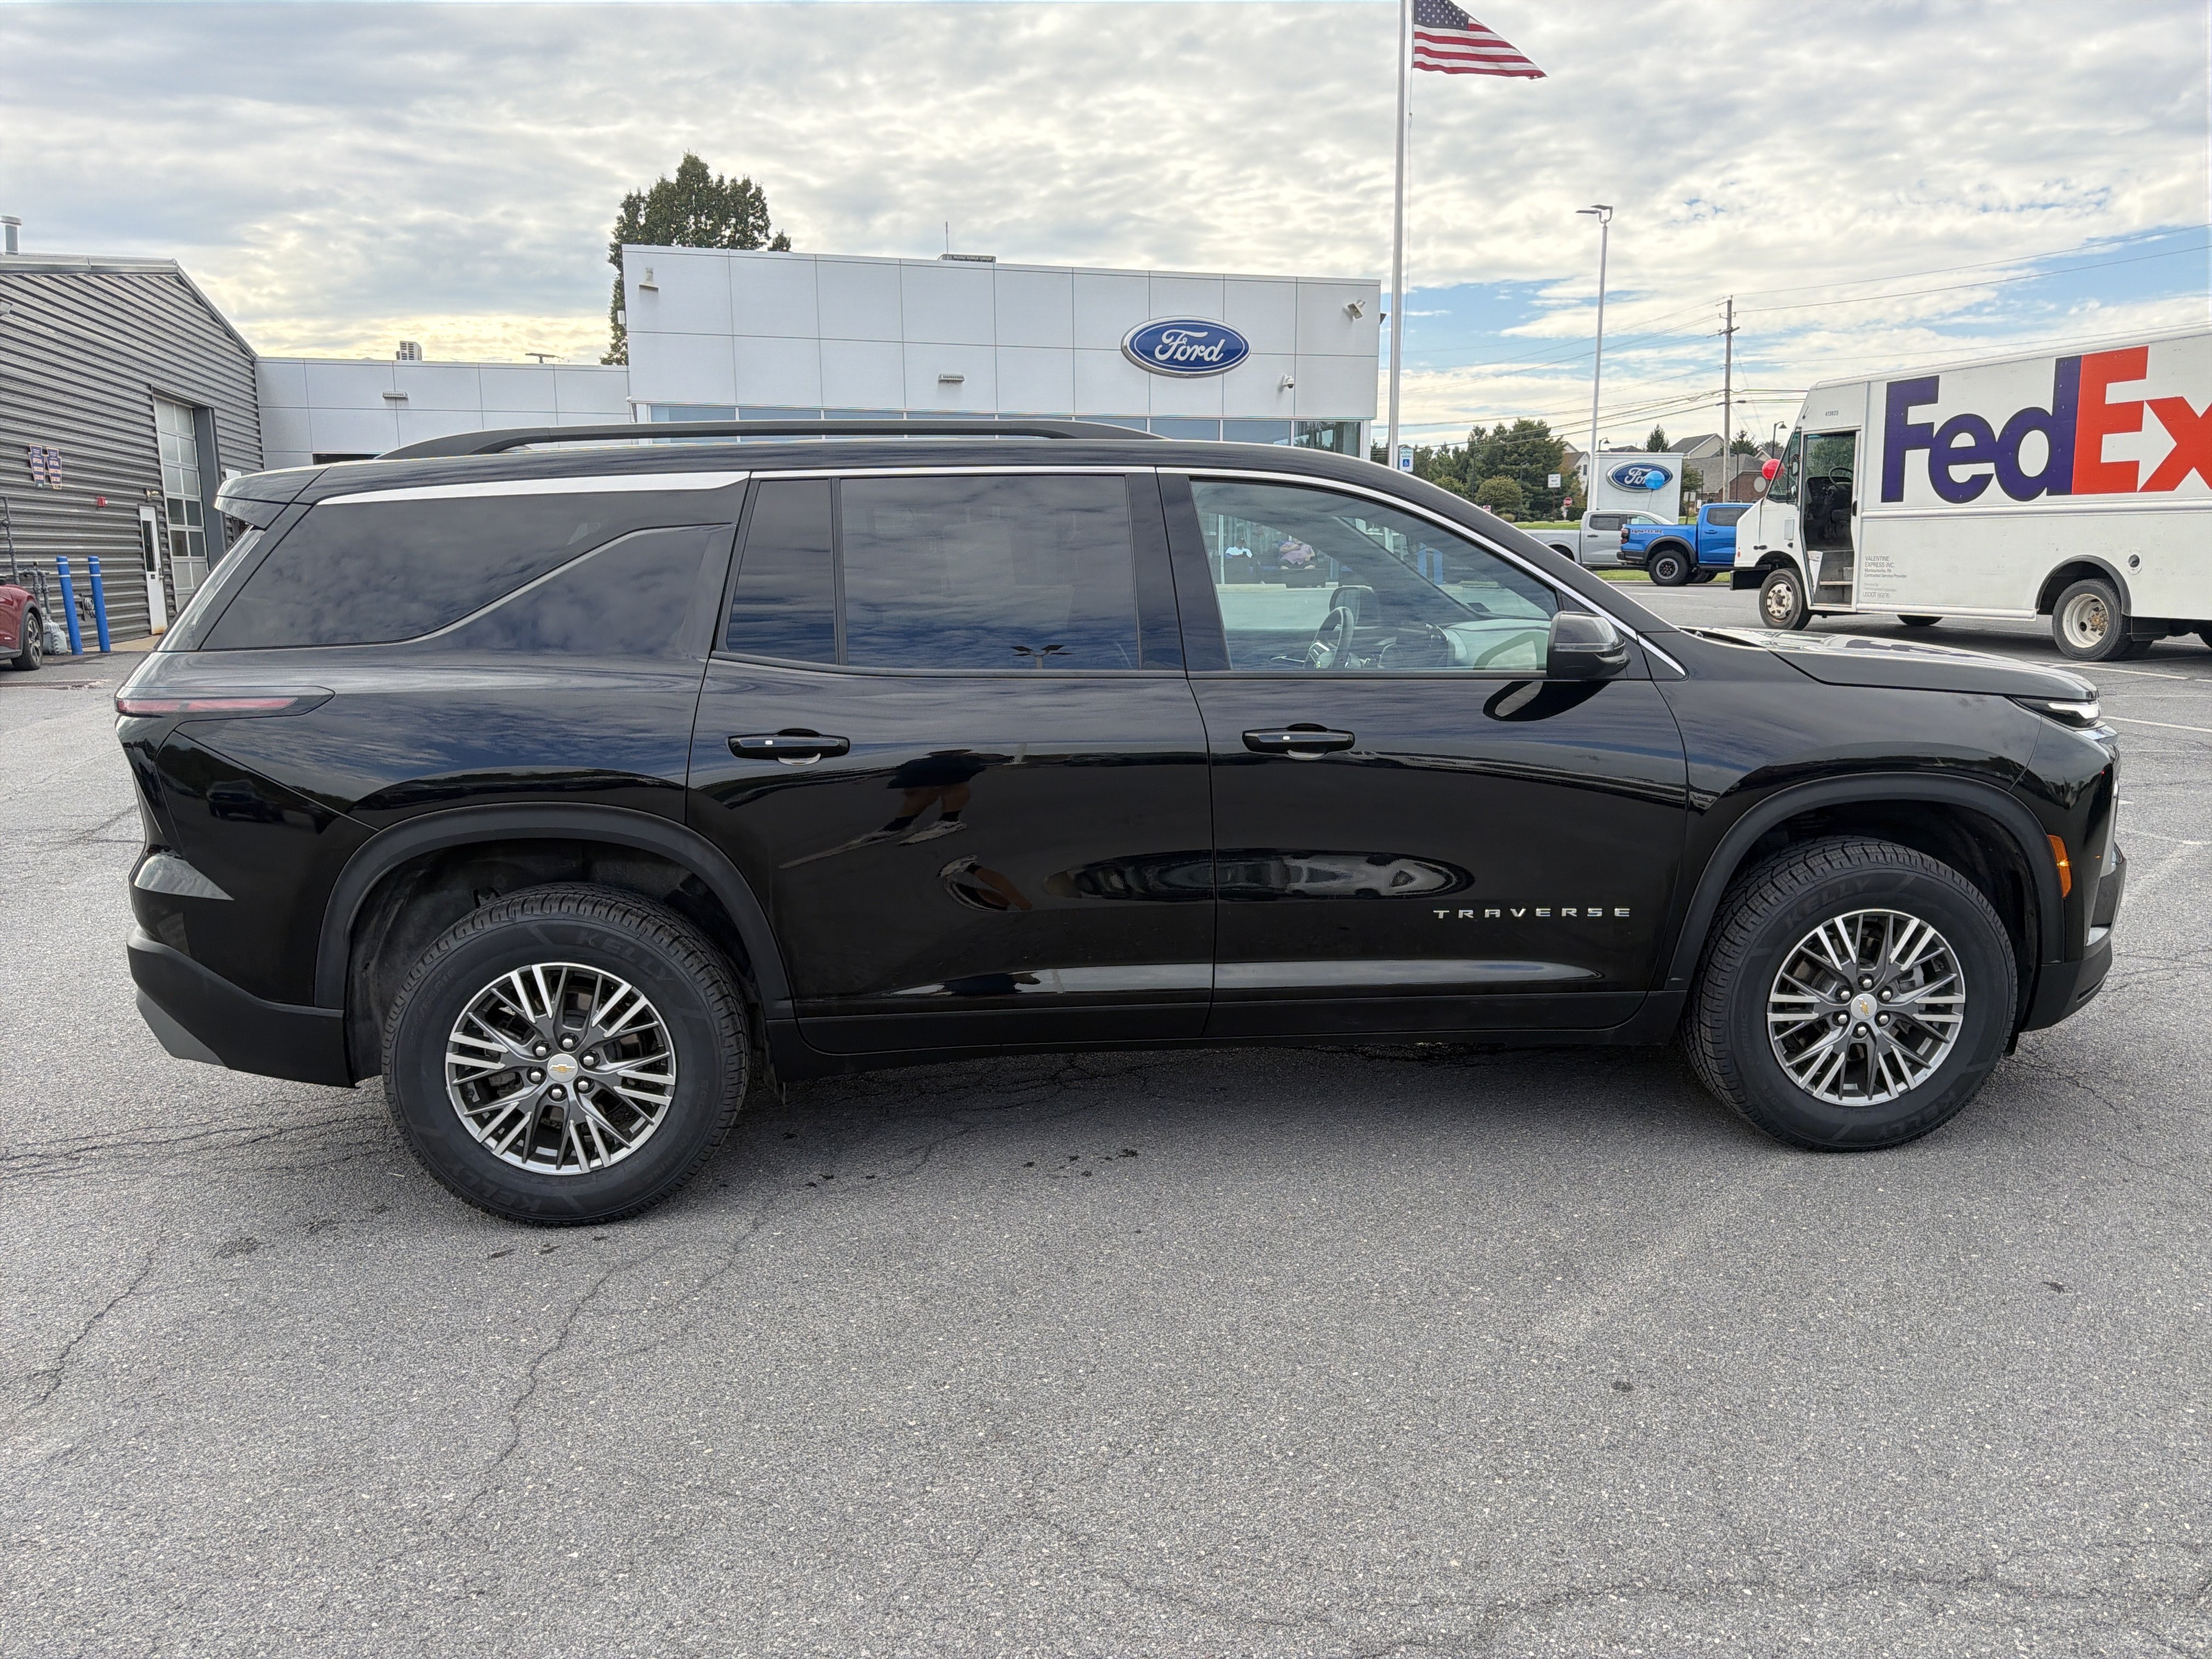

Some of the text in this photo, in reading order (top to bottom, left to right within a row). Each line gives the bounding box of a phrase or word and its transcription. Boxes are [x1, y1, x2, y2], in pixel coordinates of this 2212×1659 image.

[1154, 329, 1226, 362] Ford
[1881, 346, 2212, 504] FedEx
[1433, 908, 1630, 919] TRAVERSE
[1782, 878, 1870, 929] KELLY
[577, 930, 678, 985] KELLY
